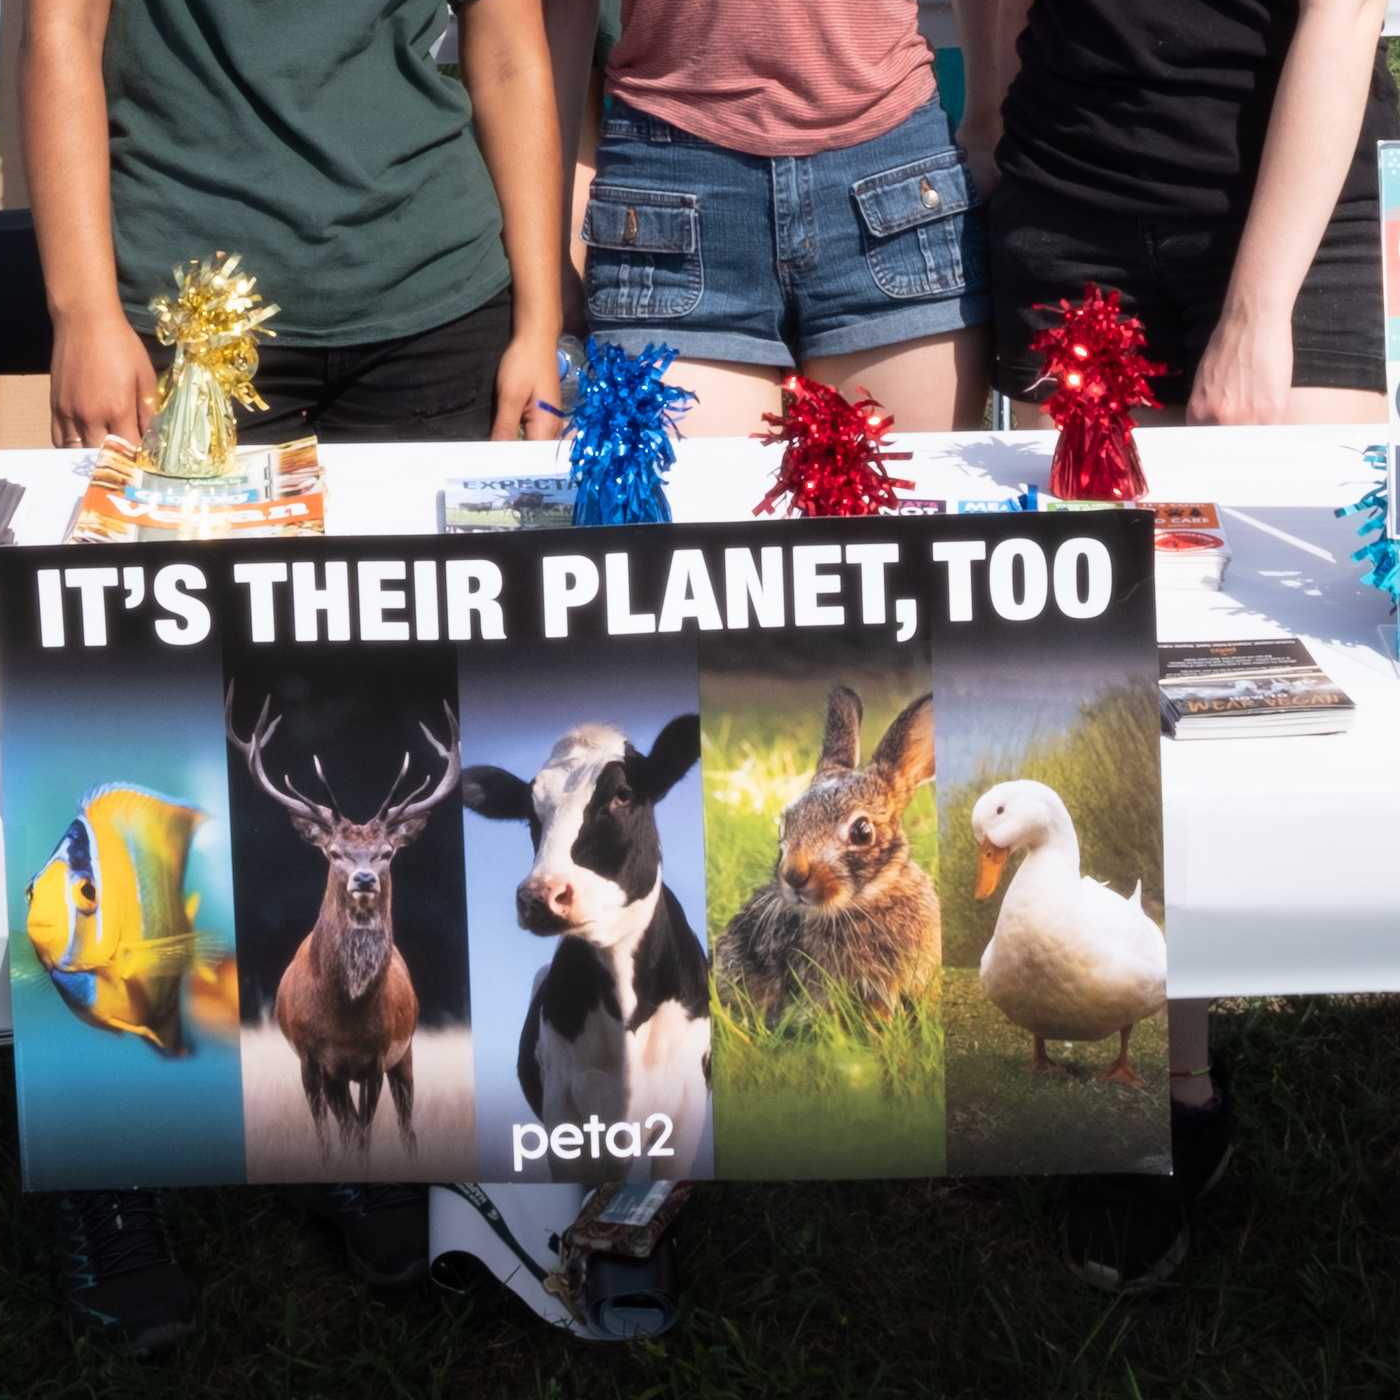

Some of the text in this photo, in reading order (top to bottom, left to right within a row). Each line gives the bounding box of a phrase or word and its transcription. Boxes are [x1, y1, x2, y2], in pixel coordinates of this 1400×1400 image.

[462, 477, 578, 491] EXPECTA
[878, 506, 939, 516] NOT
[36, 537, 1114, 649] IT'S THEIR PLANET, TOO
[1187, 694, 1339, 713] WEAR VEGAN
[512, 1112, 675, 1172] peta2
